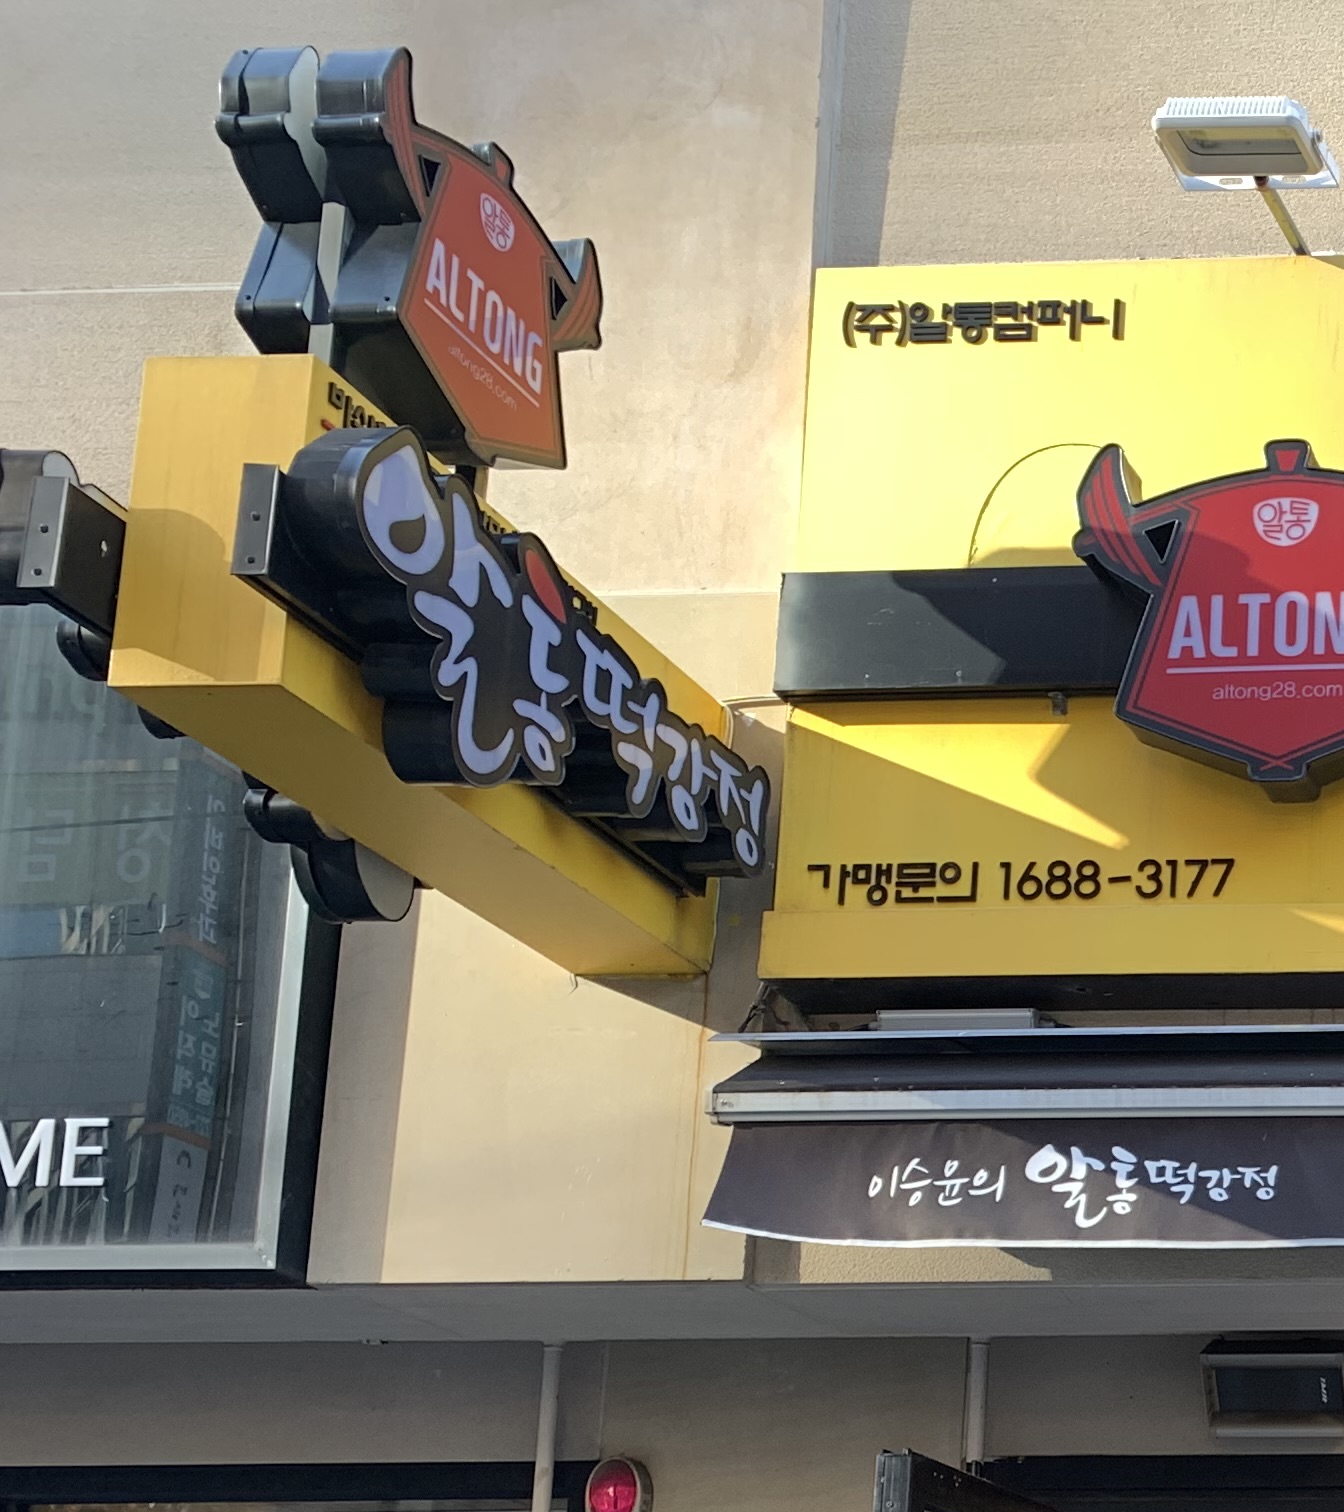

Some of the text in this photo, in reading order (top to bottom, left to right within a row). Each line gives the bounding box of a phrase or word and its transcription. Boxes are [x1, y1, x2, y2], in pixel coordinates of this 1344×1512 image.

[426, 238, 544, 396] ALTONG
[1211, 680, 1343, 702] altong28.com
[807, 858, 1236, 906] 가맹문의 1688-3177
[868, 1157, 1005, 1206] 이승윤의
[1024, 1143, 1279, 1229] 알통떡강정
